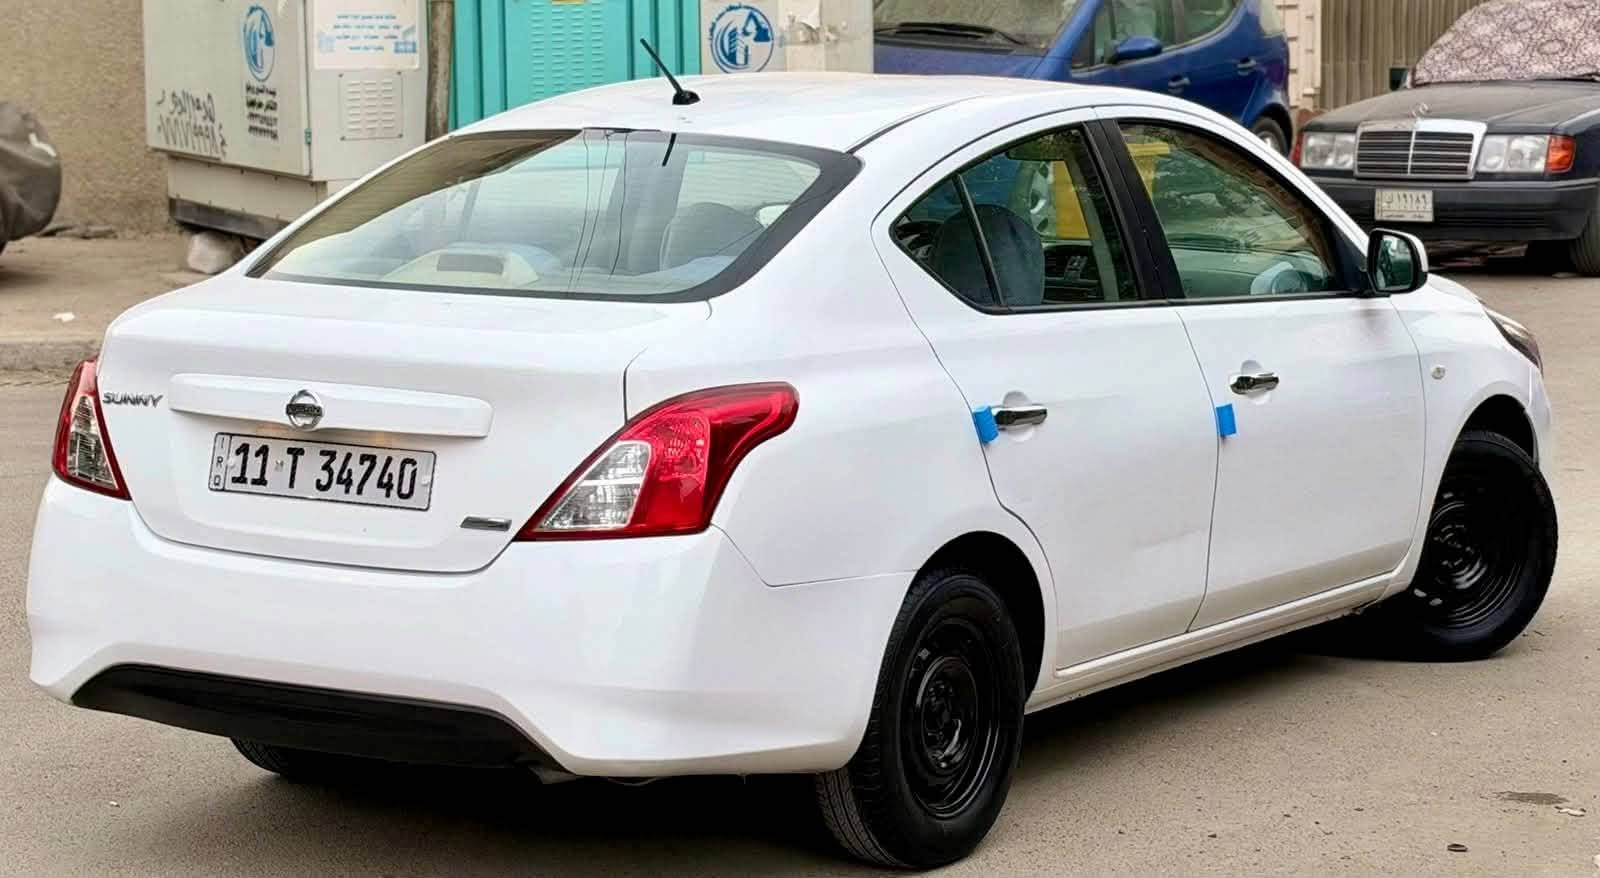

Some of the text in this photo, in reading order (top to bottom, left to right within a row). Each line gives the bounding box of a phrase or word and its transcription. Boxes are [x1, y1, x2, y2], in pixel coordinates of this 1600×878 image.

[102, 392, 164, 408] SUNNY
[231, 442, 418, 500] 11 T 34740
